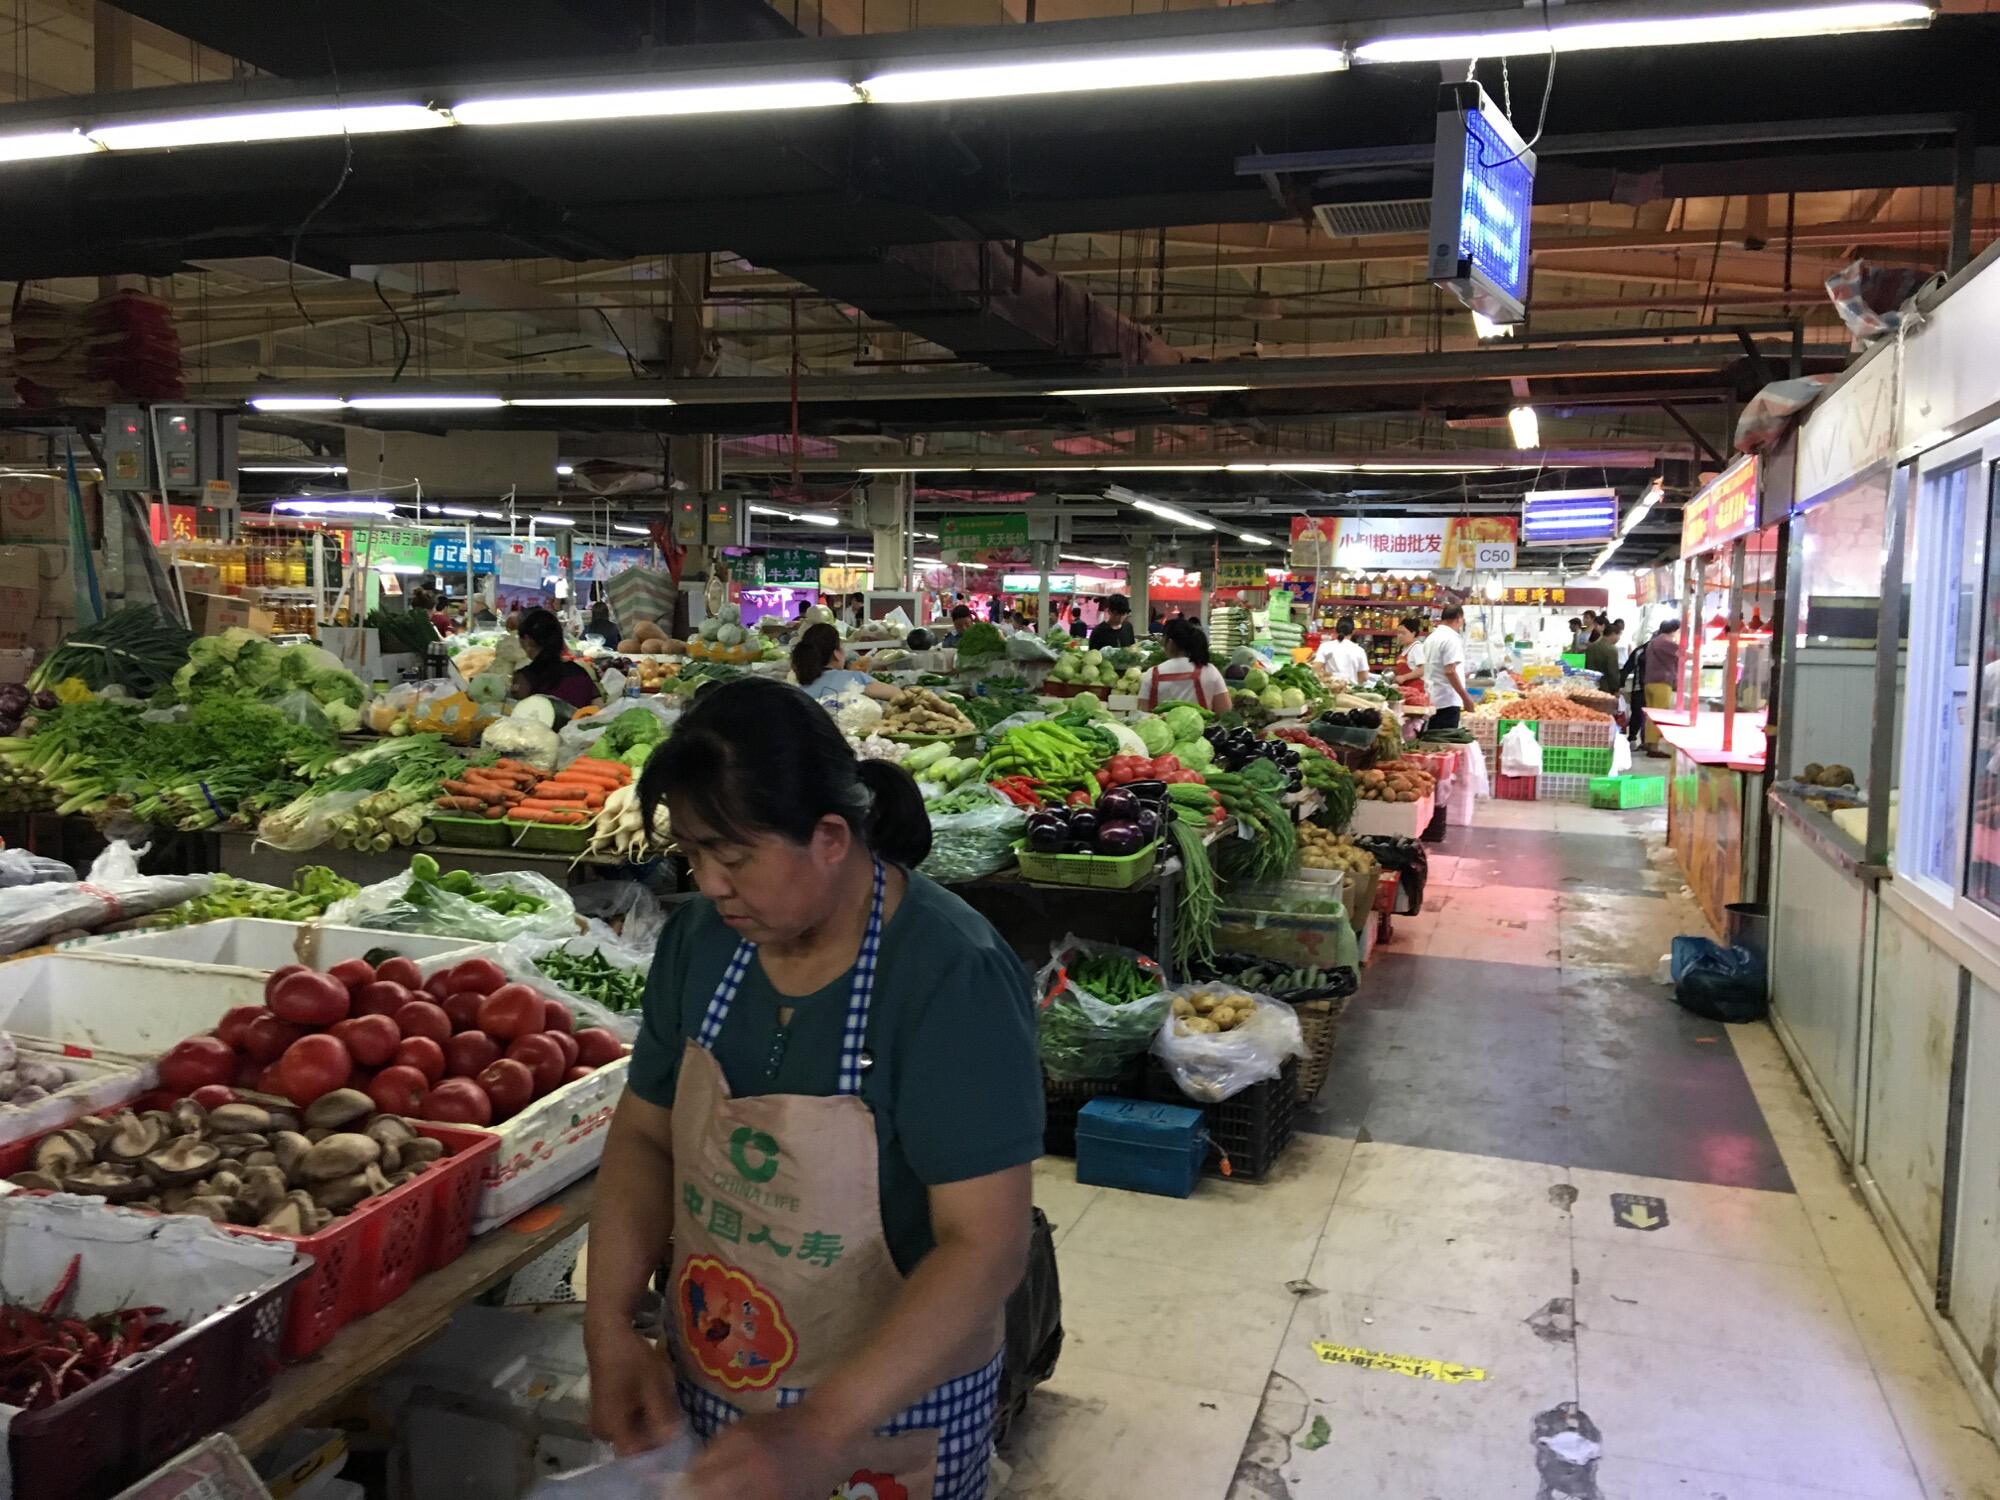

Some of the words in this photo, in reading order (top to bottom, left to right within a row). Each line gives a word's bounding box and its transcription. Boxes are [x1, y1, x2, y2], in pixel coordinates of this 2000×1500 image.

[1339, 533, 1442, 553] 小利粮油批发
[1479, 549, 1510, 563] C50
[767, 567, 818, 582] 牛羊肉
[713, 1172, 761, 1202] CHINA
[763, 1192, 800, 1213] LIFE
[682, 1180, 846, 1269] 中国人寿
